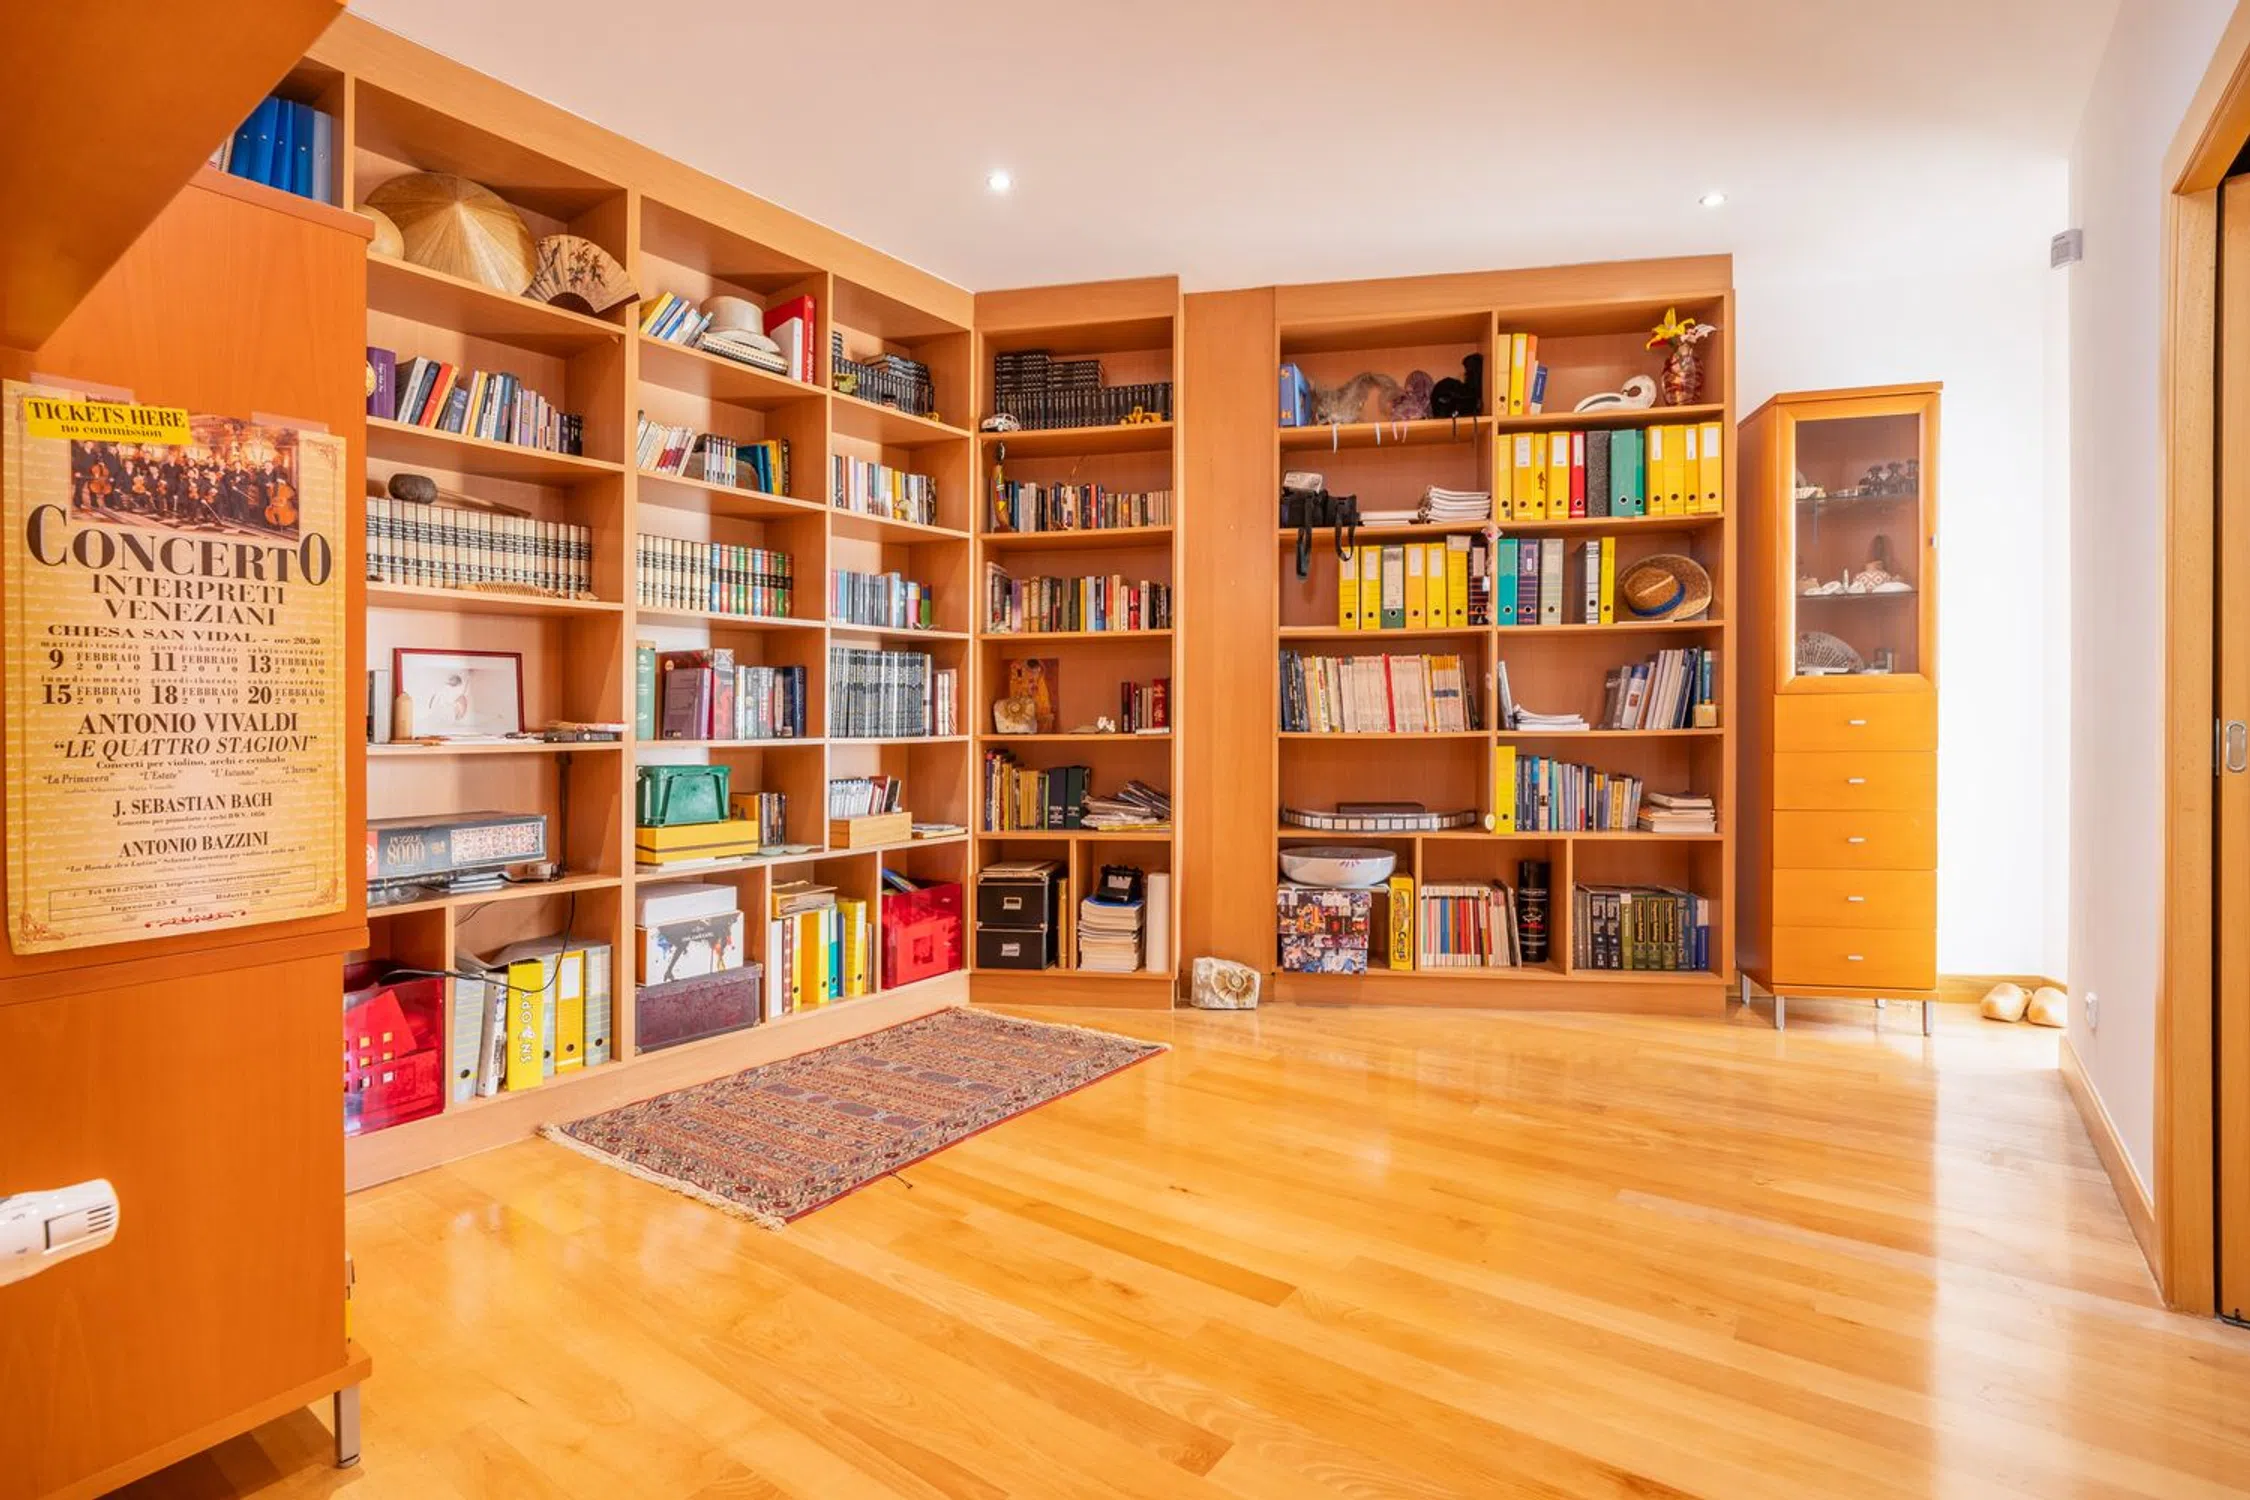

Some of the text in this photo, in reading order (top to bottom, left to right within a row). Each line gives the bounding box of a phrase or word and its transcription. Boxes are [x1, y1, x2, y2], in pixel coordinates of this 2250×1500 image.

[28, 401, 186, 428] TICKETS HERE
[61, 424, 163, 438] no commission
[26, 503, 332, 586] CONCERTO
[92, 574, 286, 605] INTERPRETI
[103, 598, 276, 626] VENEZIANI
[47, 624, 136, 639] CHIESA
[143, 628, 185, 640] SAN
[192, 630, 257, 644] VIDAL
[48, 648, 142, 670] 9 FEBBRAIO
[151, 652, 239, 672] 11 FEBBRAIO
[248, 654, 326, 673] 13 FEBBRAIO
[42, 684, 142, 705] 15 FEBBRAIO
[151, 685, 239, 705] 18 FEBBRAIO
[248, 685, 326, 705] 20 FEBBRAIO
[77, 712, 299, 735] ANTONIO VIVALDI
[102, 736, 211, 761] QUATTRO
[96, 759, 144, 770] Concerti
[147, 761, 164, 770] per
[210, 756, 236, 765] archi
[113, 791, 272, 818] J. SEBASTIAN BACH
[119, 831, 269, 858] ANTONIO BAZZINI
[387, 840, 425, 865] 8000
